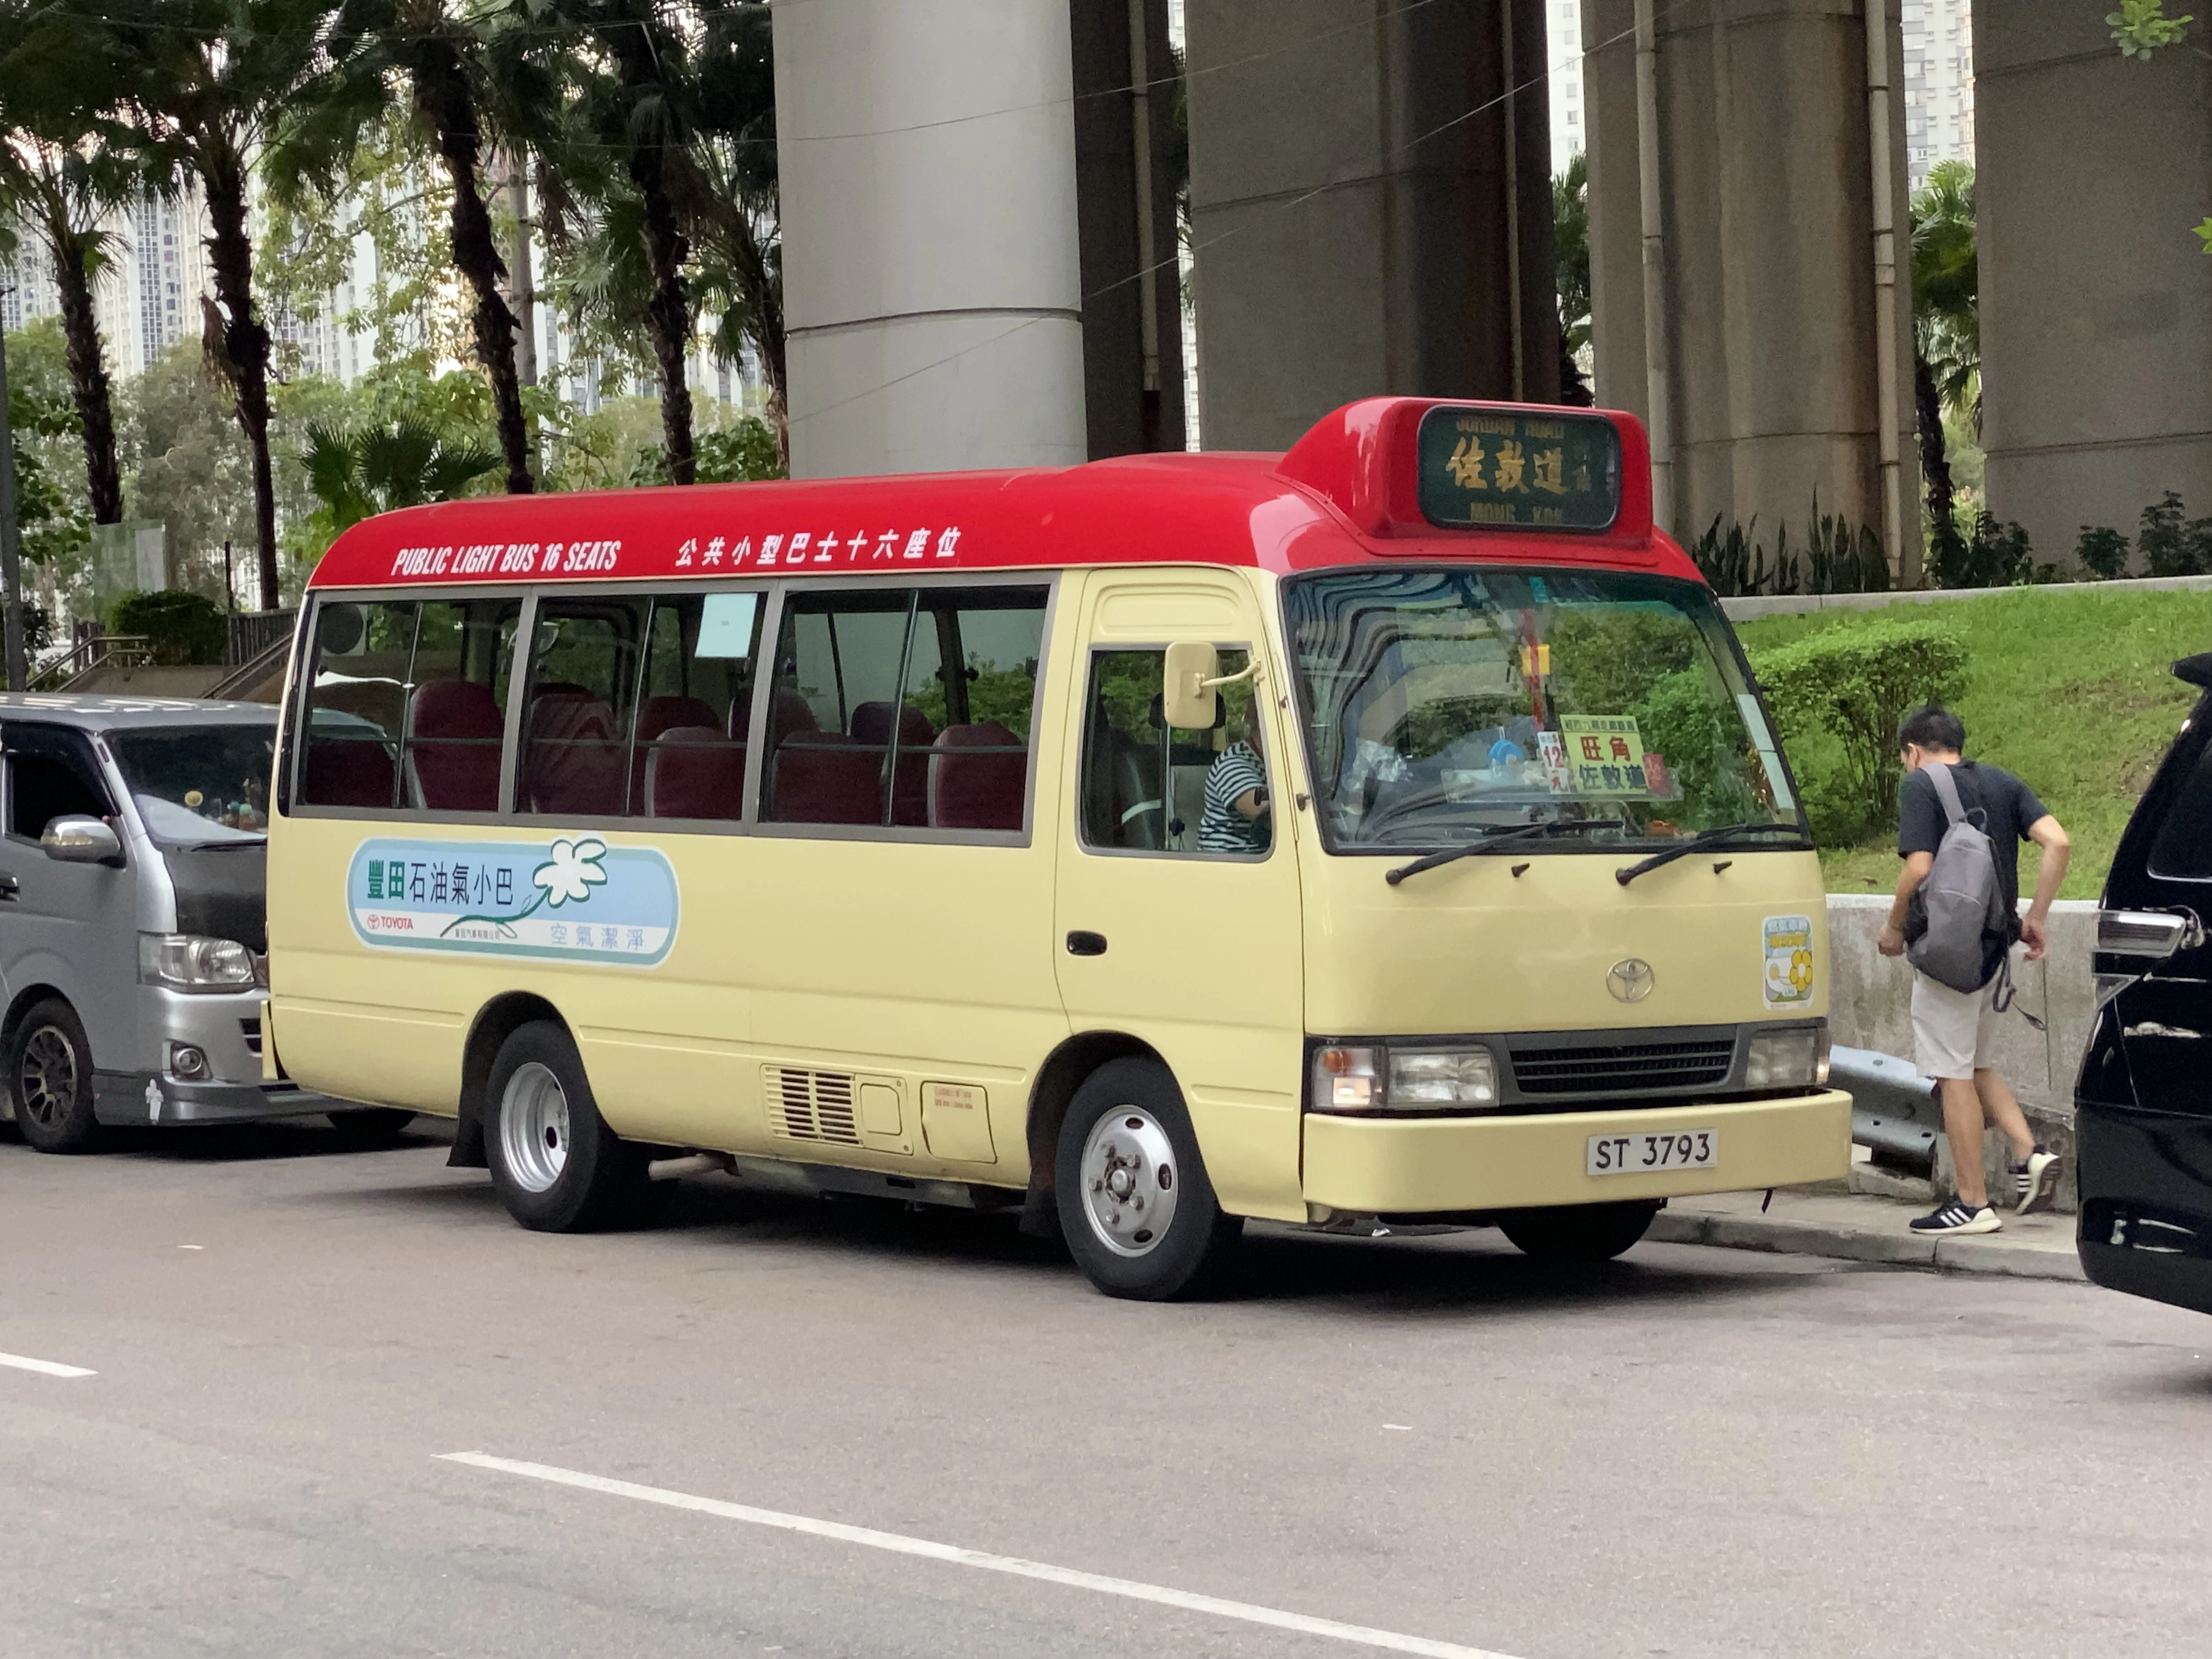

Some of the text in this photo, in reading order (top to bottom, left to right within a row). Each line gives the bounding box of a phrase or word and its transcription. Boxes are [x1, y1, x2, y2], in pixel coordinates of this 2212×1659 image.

[391, 540, 621, 575] PUBLIC LIGHT BUS 16 SEATS
[675, 526, 961, 566] 公共小型巴士十六座位
[1580, 736, 1631, 761] 旺角
[367, 859, 513, 906] 豐田石油氣小巴
[381, 916, 413, 930] TOYOTA
[550, 923, 644, 951] 空氣潔淨
[1596, 1133, 1709, 1169] ST 3793
